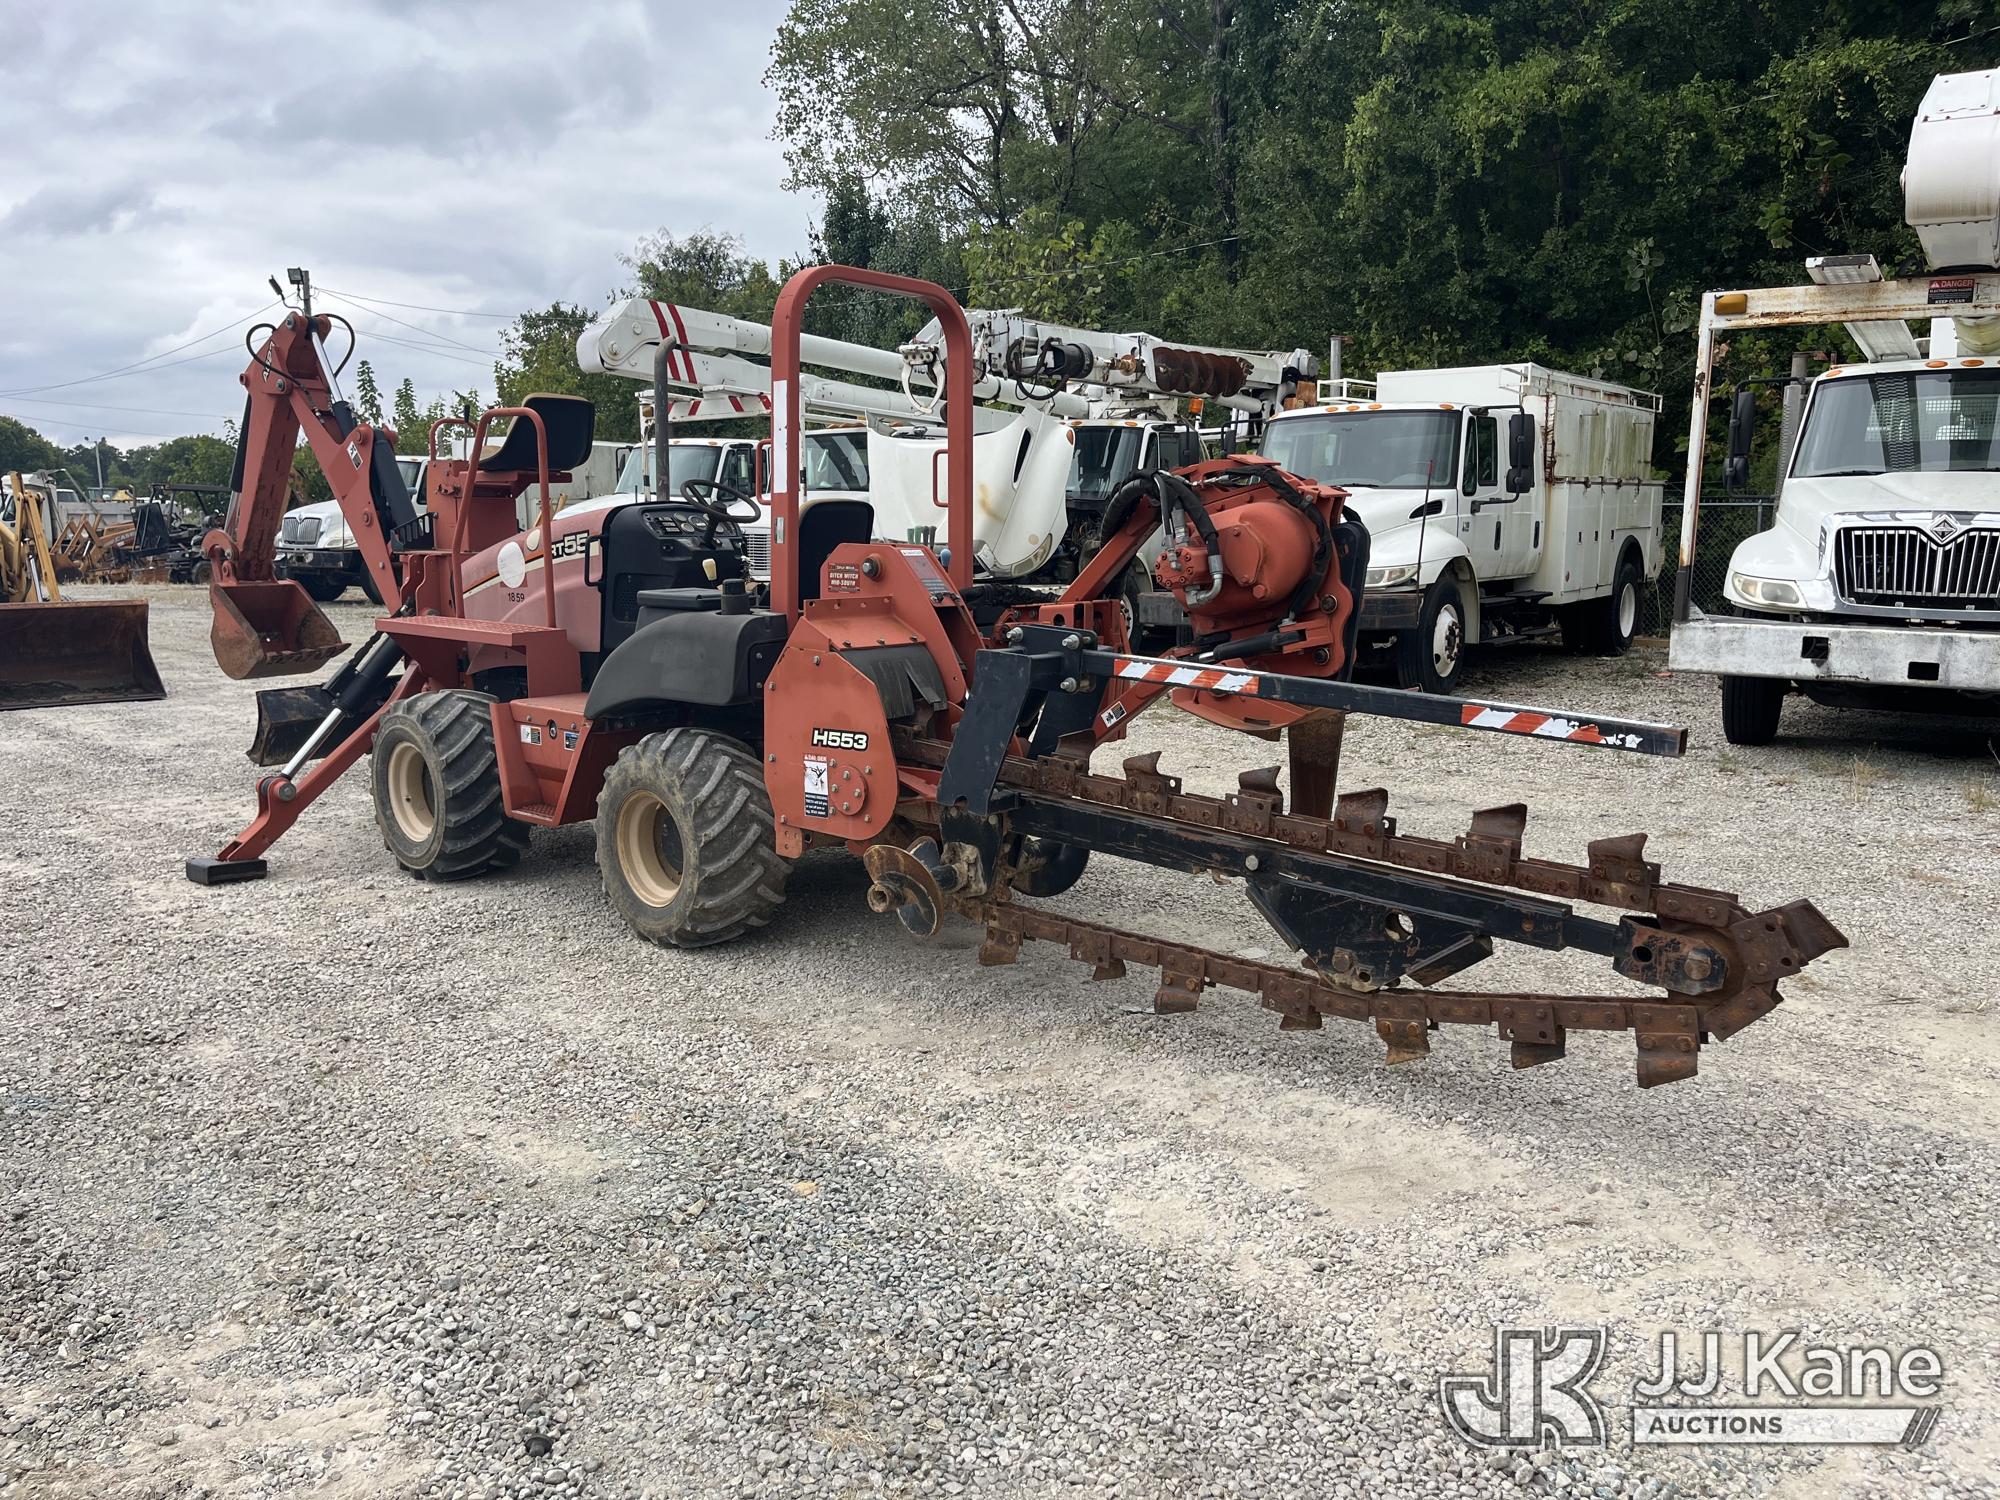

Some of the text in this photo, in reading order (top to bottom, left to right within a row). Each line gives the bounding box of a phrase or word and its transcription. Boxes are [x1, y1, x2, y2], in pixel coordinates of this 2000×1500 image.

[1941, 280, 1973, 288] DANGER
[508, 592, 525, 602] 1859
[812, 729, 868, 750] H553
